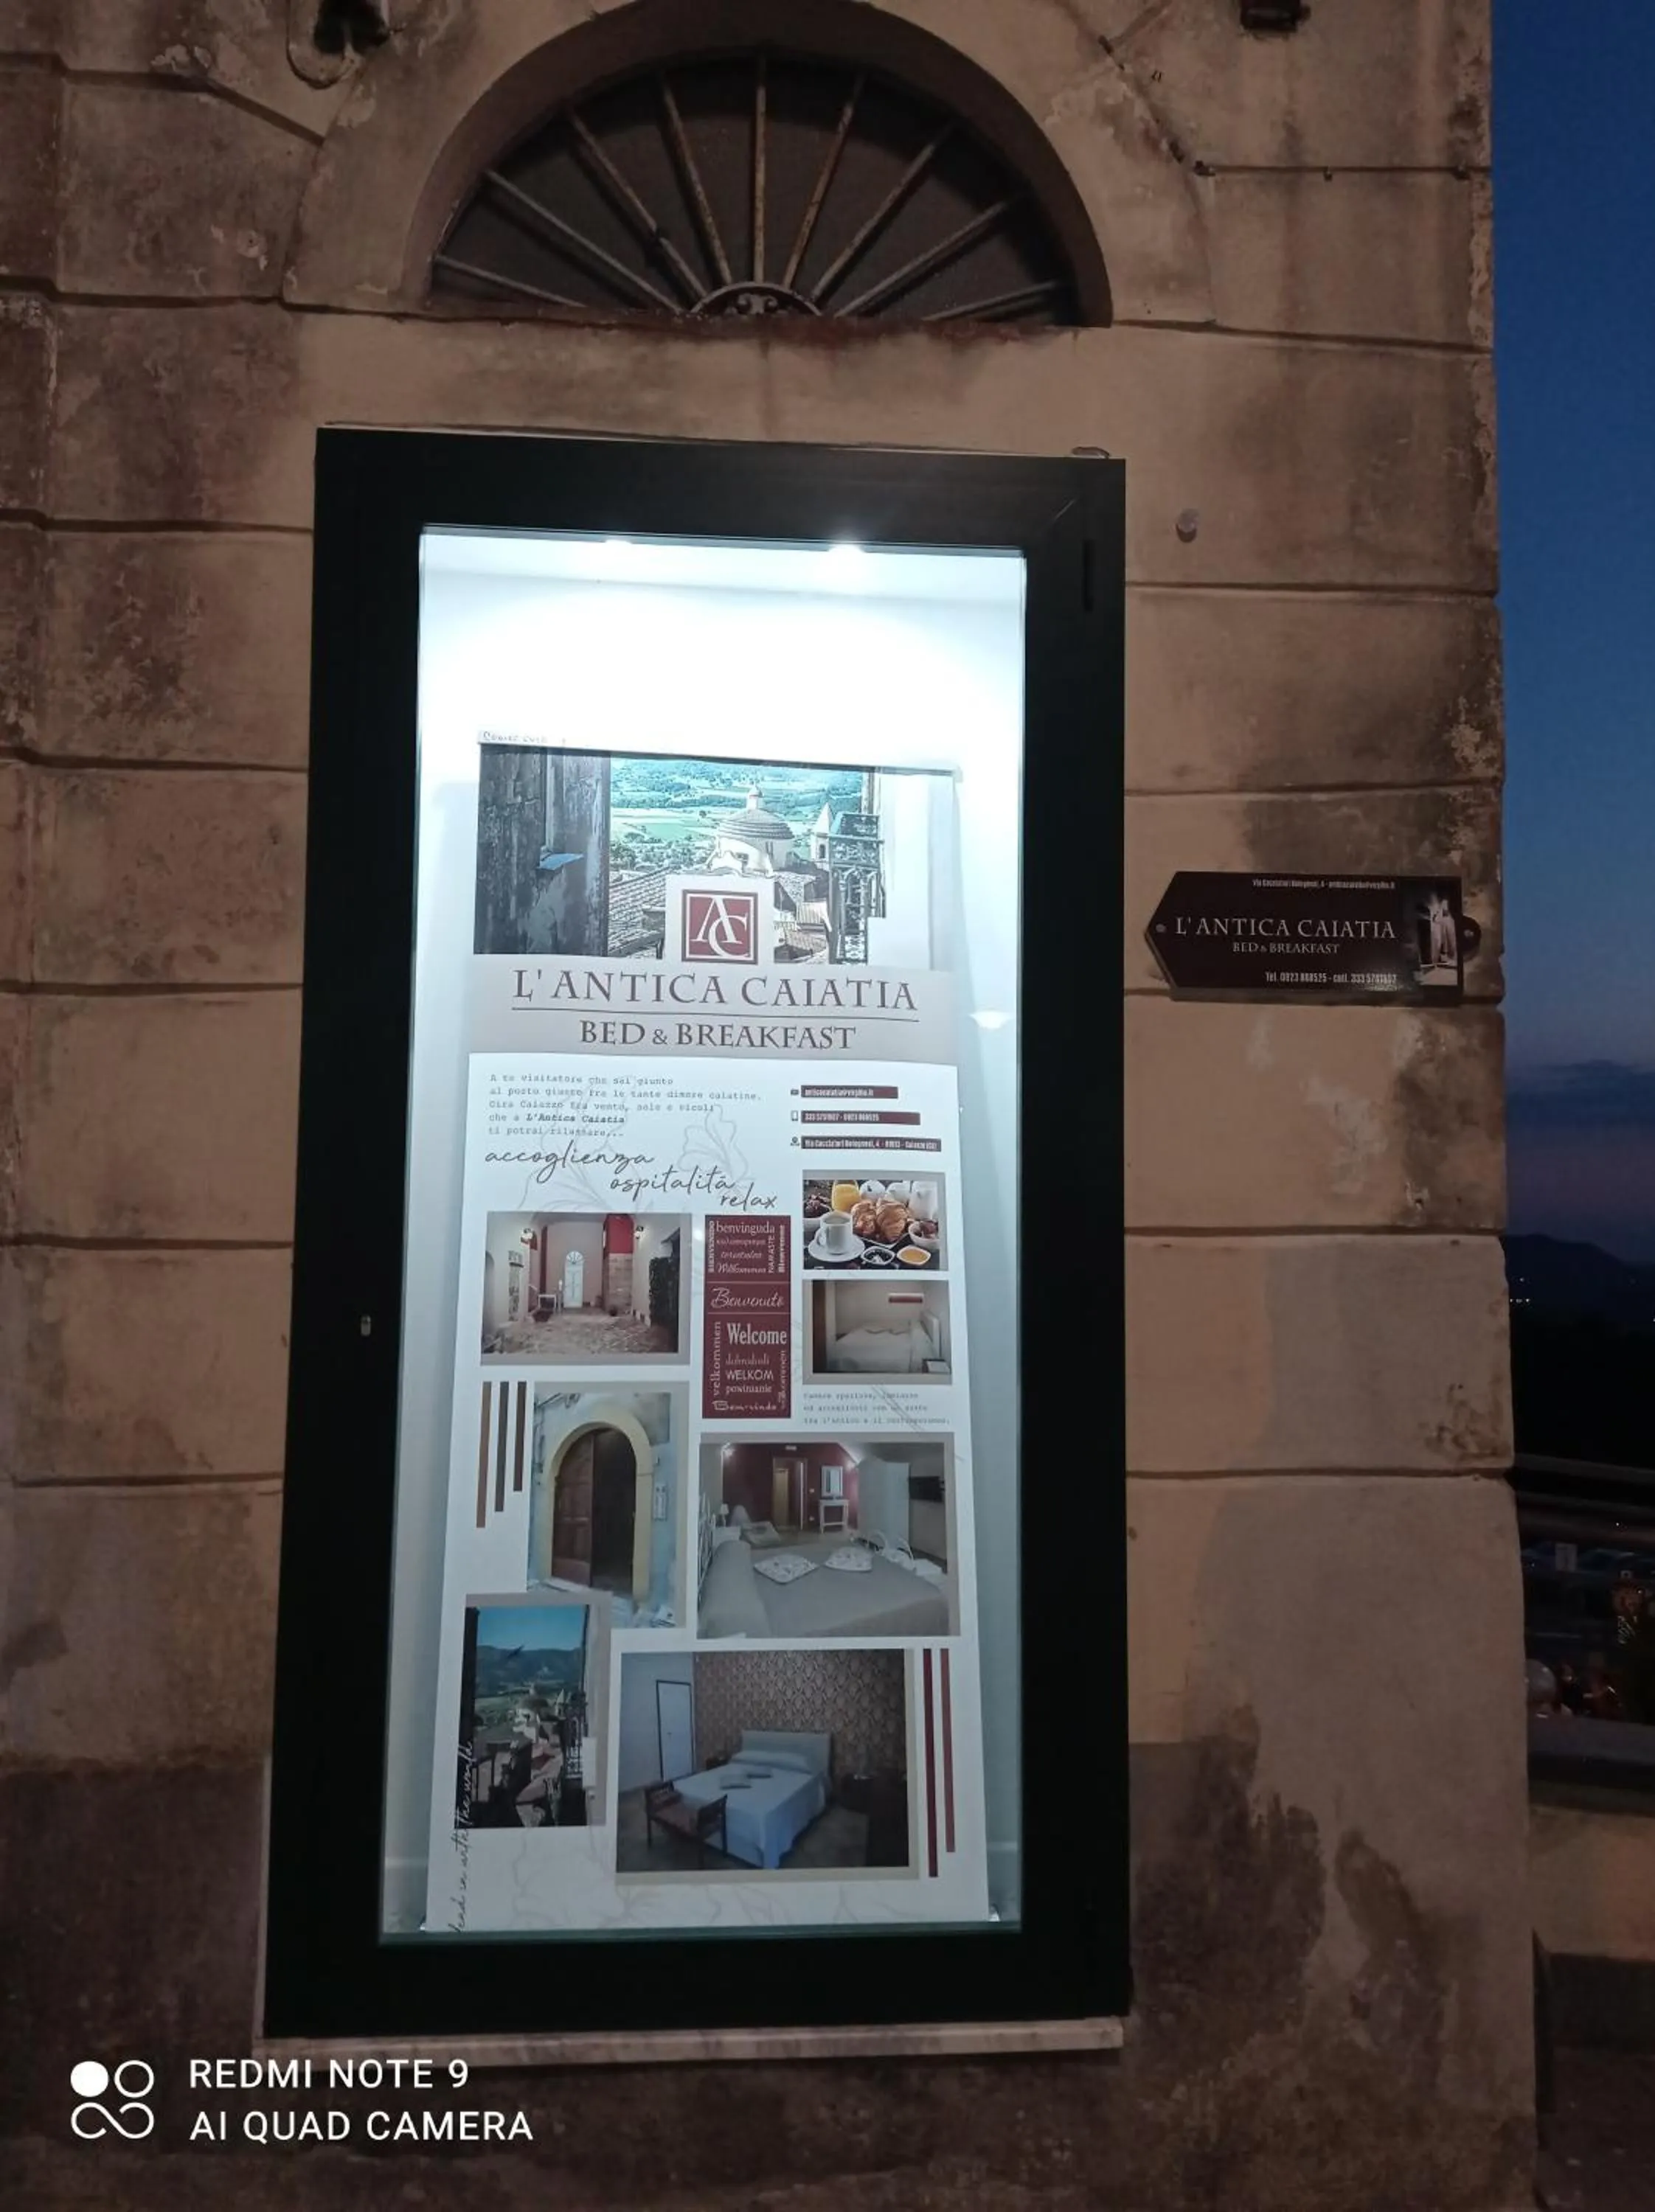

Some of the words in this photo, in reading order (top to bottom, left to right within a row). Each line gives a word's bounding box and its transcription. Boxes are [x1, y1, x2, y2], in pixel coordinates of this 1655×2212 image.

[1176, 917, 1290, 937] L'ANTICA
[1297, 919, 1396, 939] CAIATIA
[1232, 942, 1258, 953] BED
[1269, 942, 1340, 955] BREAKFAST
[512, 969, 726, 1004] L'ANTICA
[741, 975, 918, 1011] CAIATIA
[580, 1020, 646, 1045] BED
[652, 1029, 668, 1044] &
[677, 1021, 856, 1051] BREAKFAST
[636, 1077, 673, 1087] giunto
[485, 1140, 655, 1183] accoglienza
[721, 1182, 777, 1212] relax
[715, 1220, 775, 1236] benvinguda
[726, 1322, 788, 1346] Welcome
[725, 1369, 774, 1381] WELKOM
